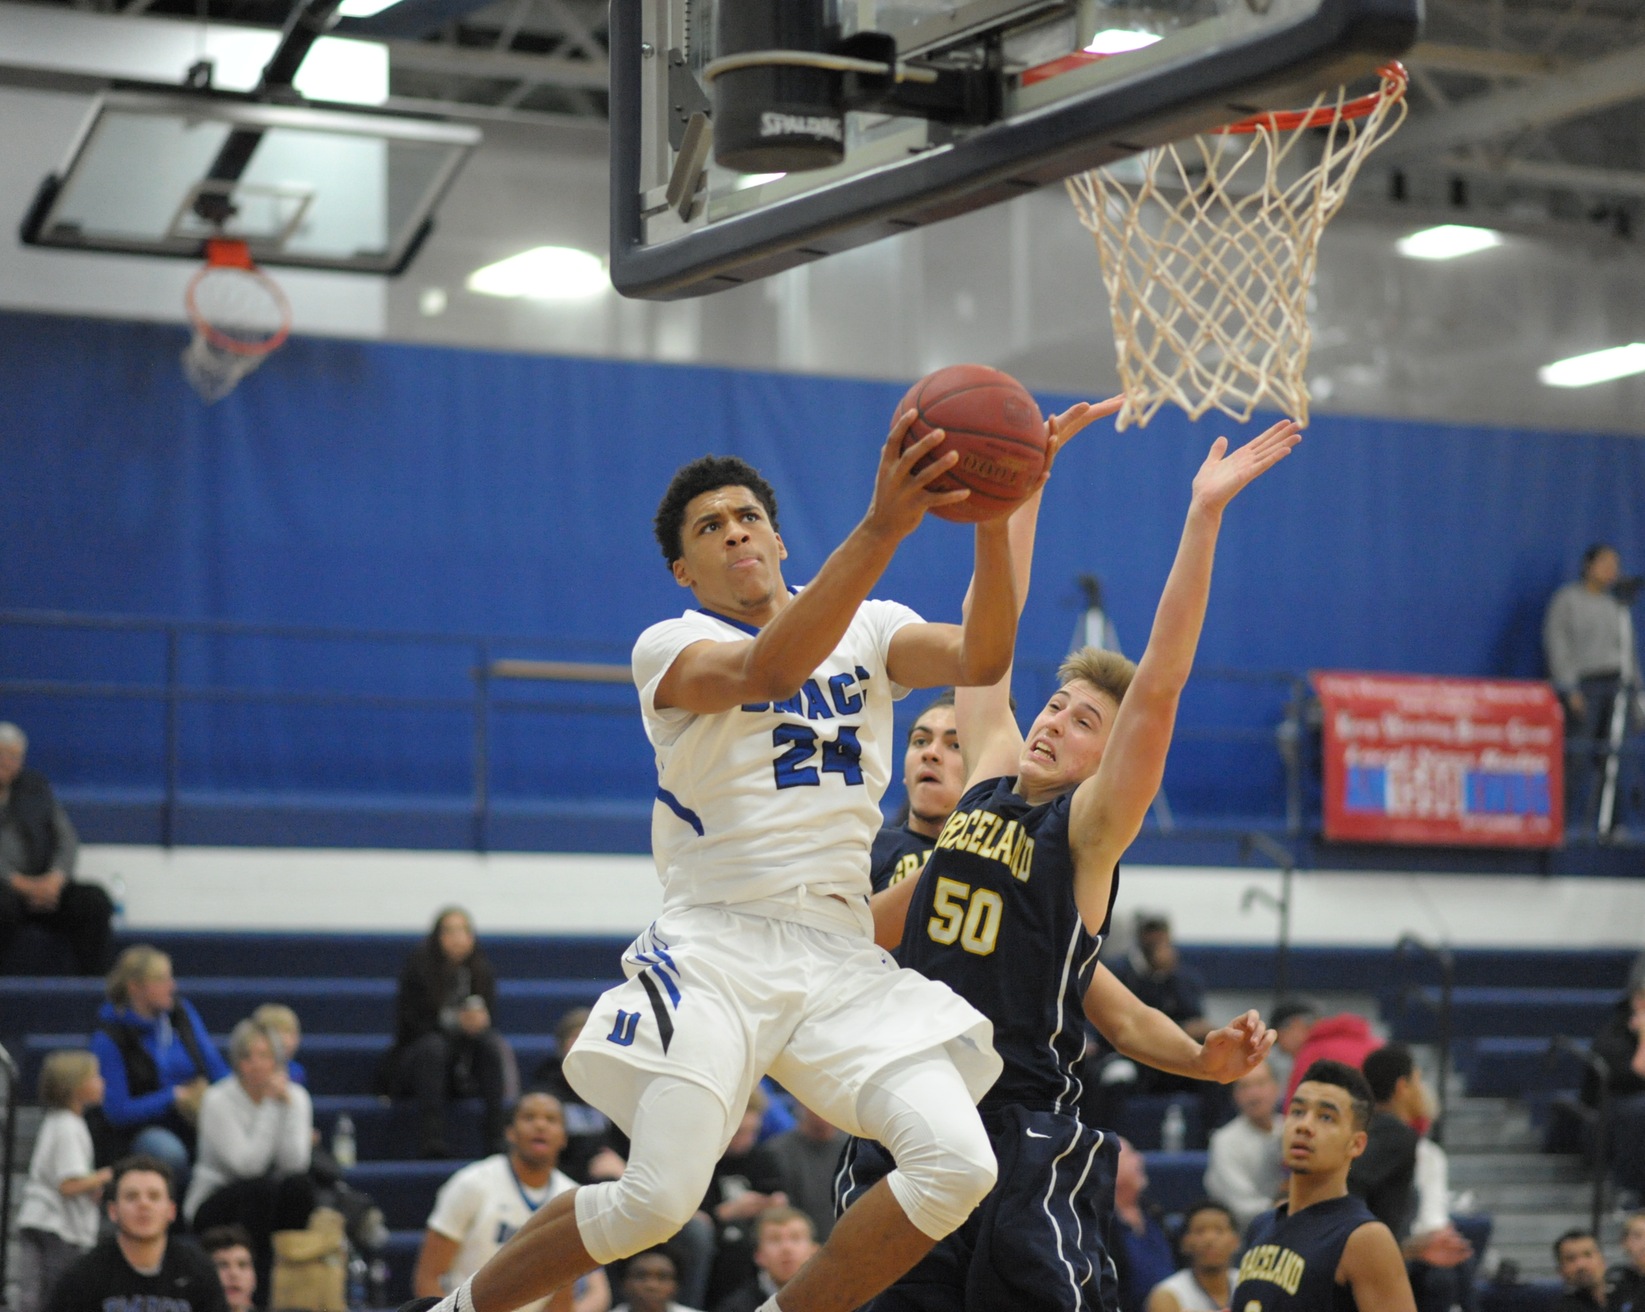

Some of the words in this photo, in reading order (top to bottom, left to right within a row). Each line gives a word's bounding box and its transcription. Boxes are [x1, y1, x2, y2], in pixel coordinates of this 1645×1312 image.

[760, 112, 842, 143] SPALDING
[773, 723, 864, 790] 24
[927, 876, 1004, 957] 50
